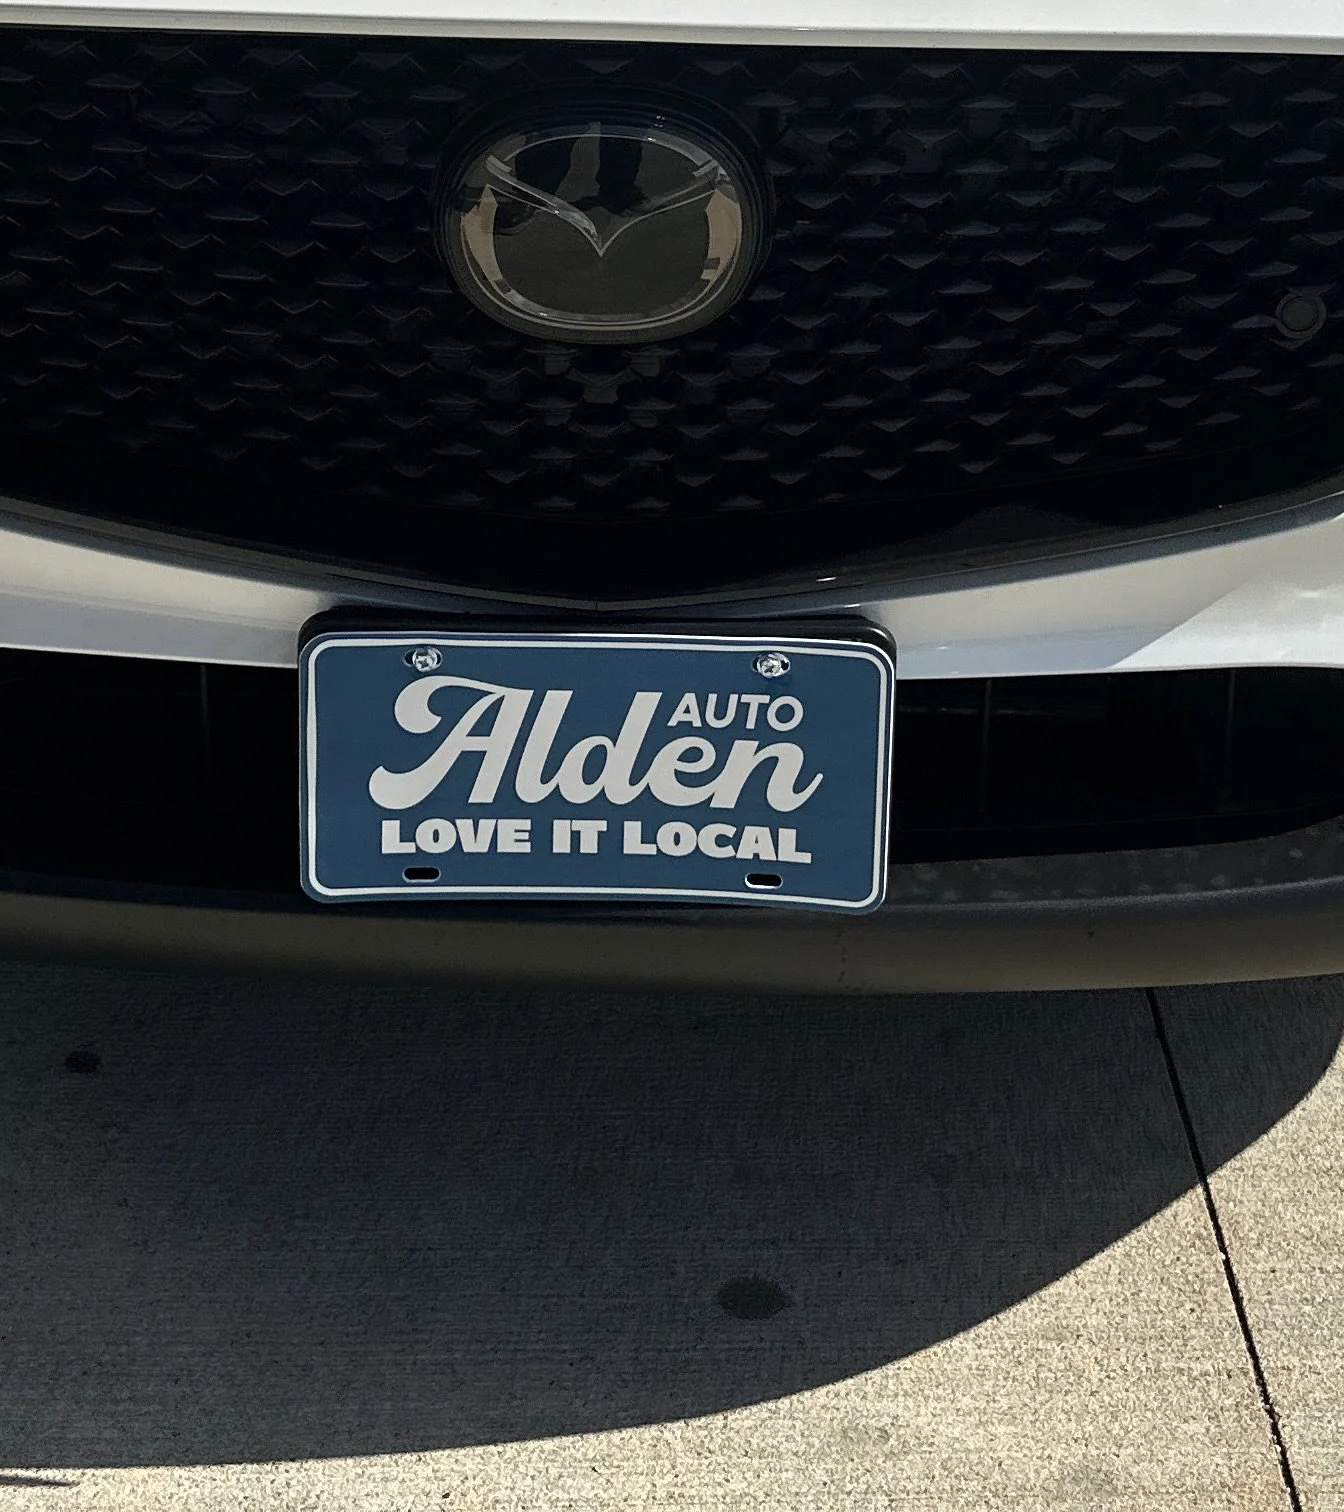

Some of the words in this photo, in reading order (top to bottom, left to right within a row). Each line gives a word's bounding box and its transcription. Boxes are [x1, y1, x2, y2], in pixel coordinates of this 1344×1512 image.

[666, 692, 804, 731] AUTO
[368, 675, 824, 812] Alden
[381, 818, 532, 854] LOVE
[552, 819, 608, 854] IT
[623, 820, 812, 864] LOCAL
